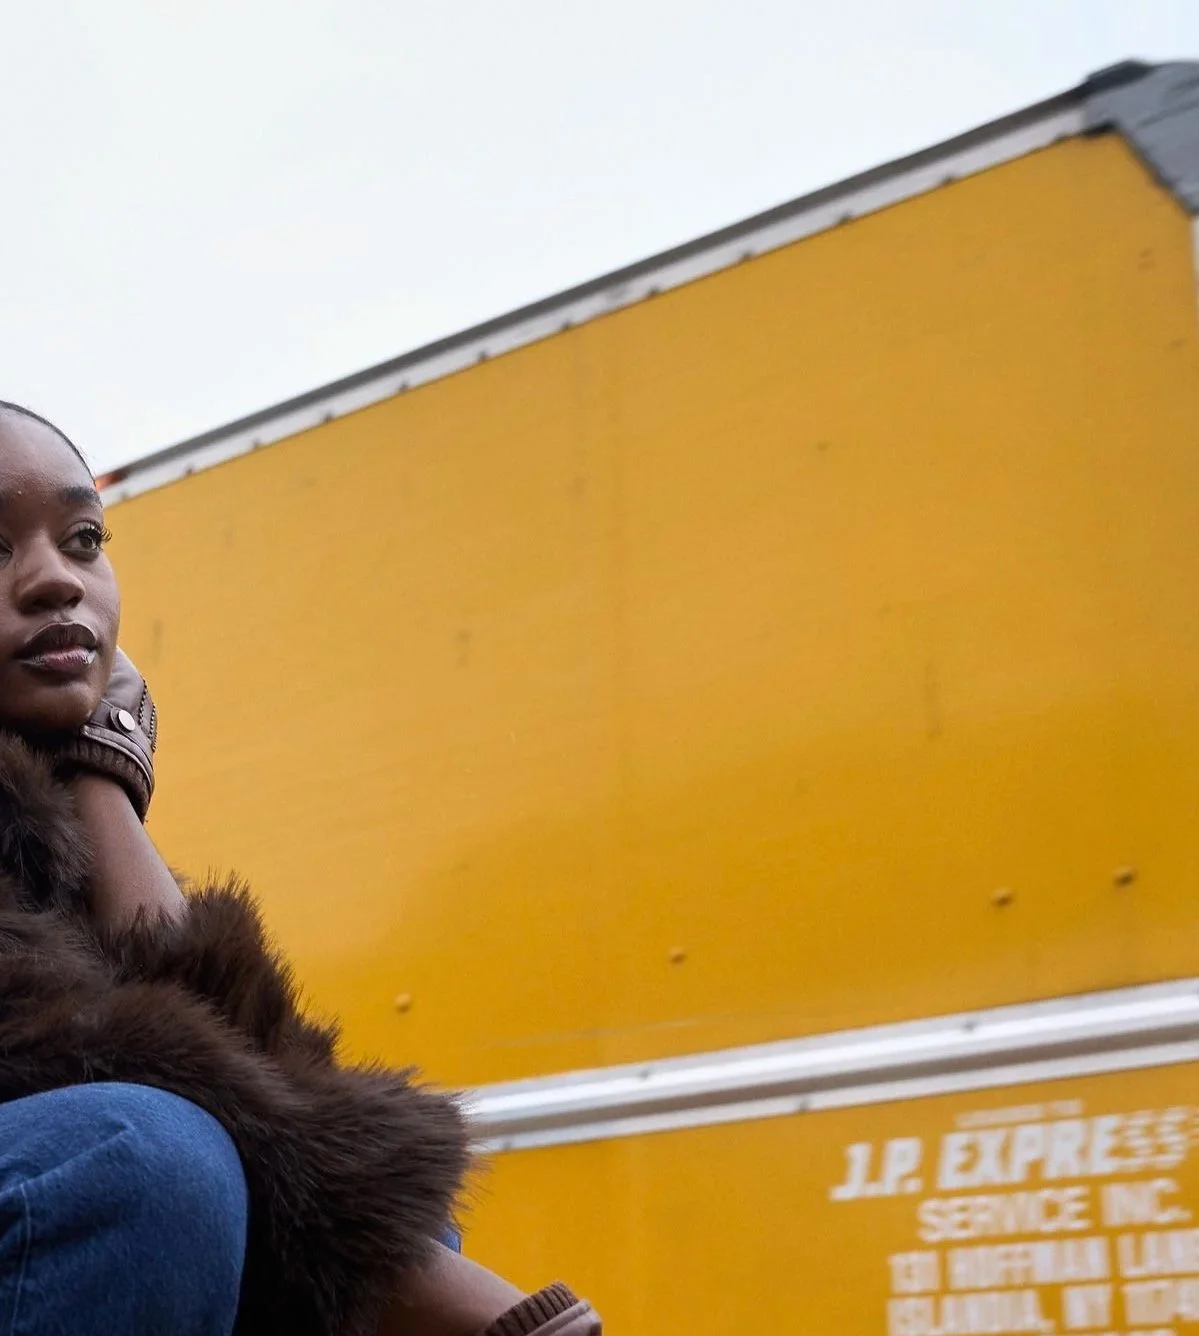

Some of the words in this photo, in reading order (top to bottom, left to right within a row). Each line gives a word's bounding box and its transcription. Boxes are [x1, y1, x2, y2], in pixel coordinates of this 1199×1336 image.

[829, 1137, 923, 1201] J.P.
[937, 1106, 1191, 1191] EXPRESS
[917, 1186, 1091, 1243] SERVICE
[1102, 1178, 1192, 1227] INC.
